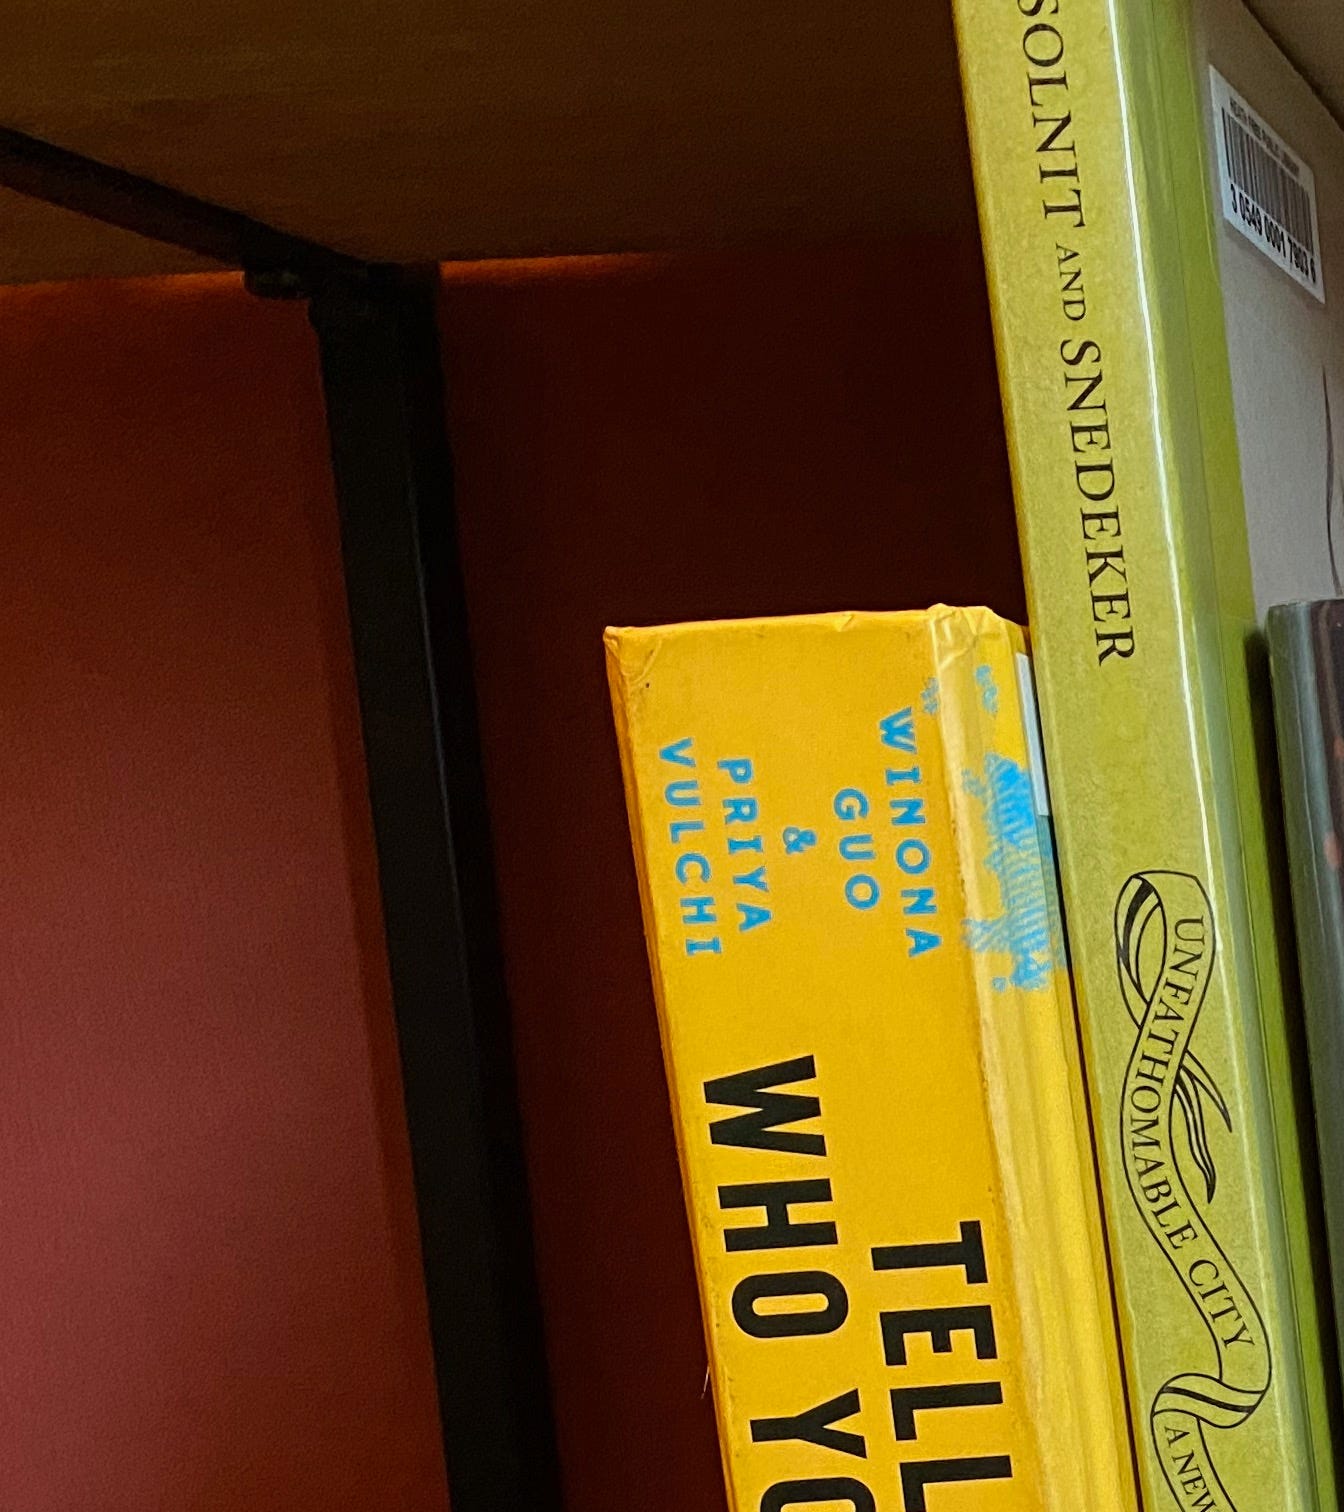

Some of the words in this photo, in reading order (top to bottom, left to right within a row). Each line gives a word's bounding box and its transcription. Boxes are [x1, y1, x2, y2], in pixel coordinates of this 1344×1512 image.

[1055, 242, 1087, 323] AND
[1059, 337, 1137, 667] SNEDEKER
[658, 736, 722, 957] VULCHI
[716, 757, 774, 933] PRIYA
[781, 826, 818, 855] &
[832, 787, 881, 912] GUO
[878, 706, 943, 958] WINONA
[702, 1053, 850, 1340] WHO
[1130, 915, 1205, 1251] UNFATHOMABLE
[1188, 1258, 1256, 1350] CITY
[1163, 1424, 1192, 1447] A
